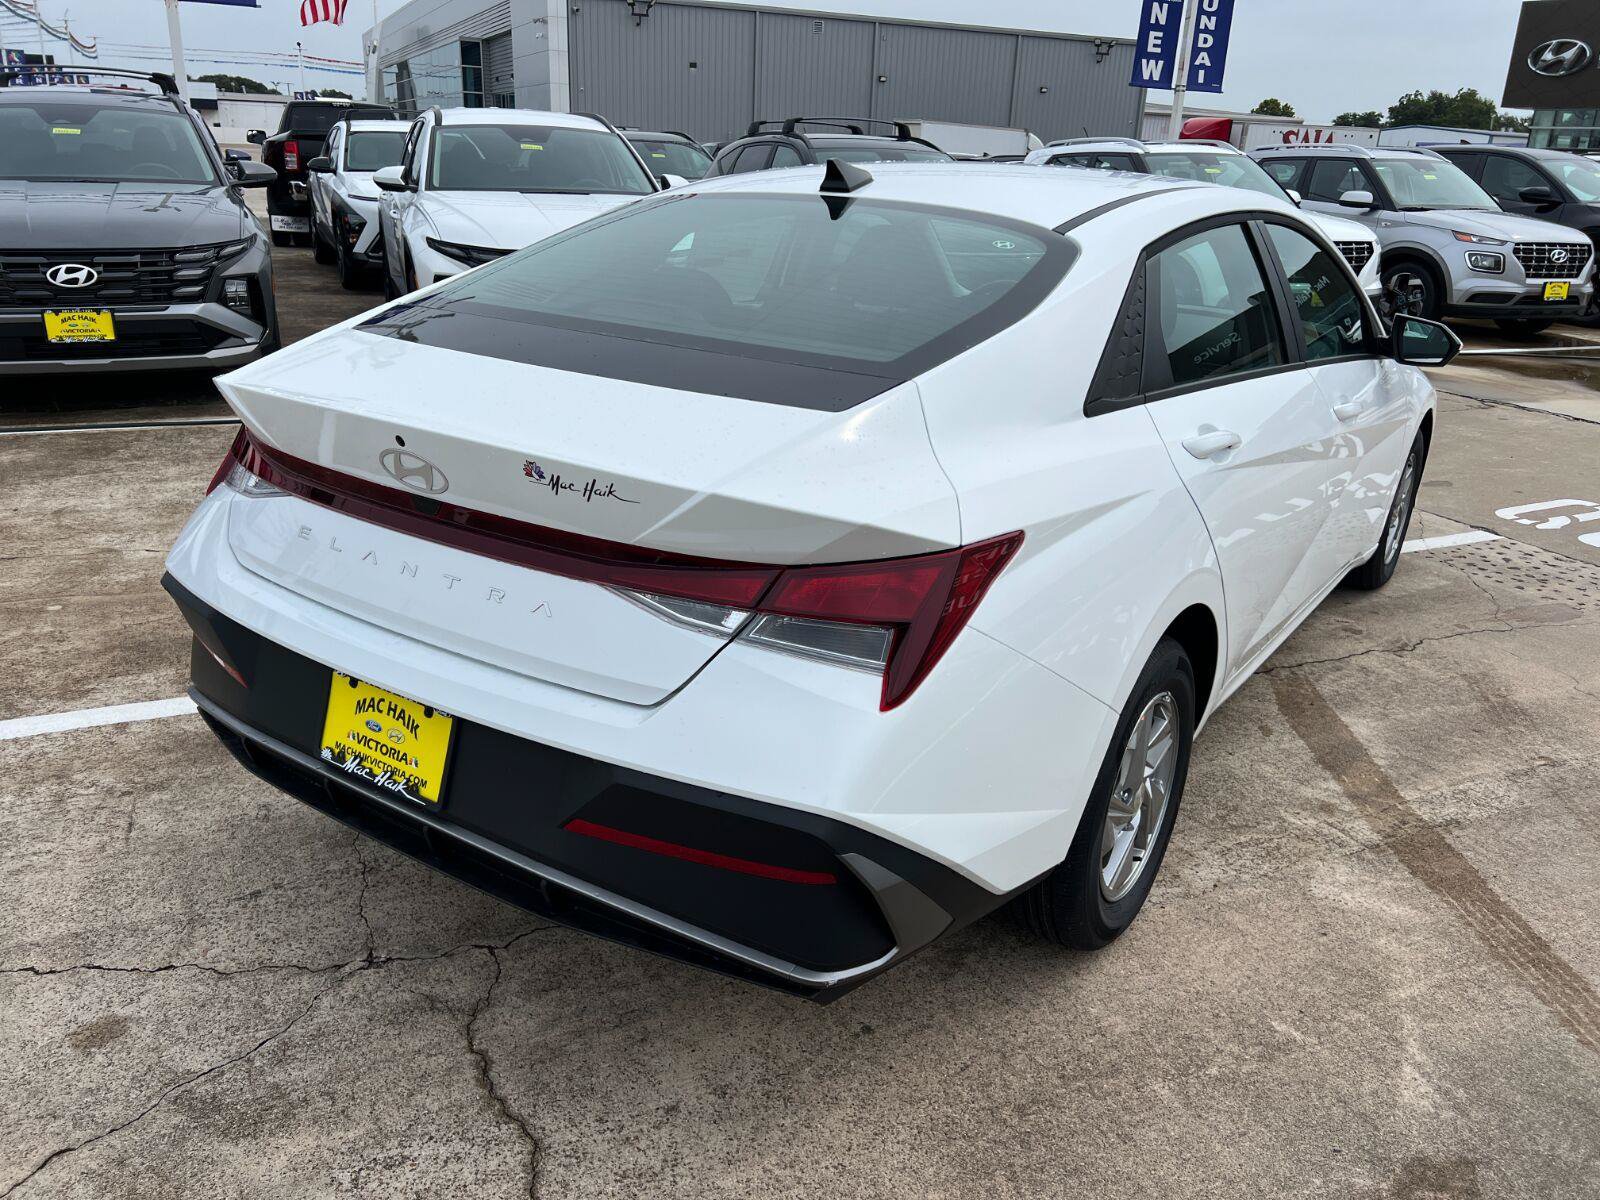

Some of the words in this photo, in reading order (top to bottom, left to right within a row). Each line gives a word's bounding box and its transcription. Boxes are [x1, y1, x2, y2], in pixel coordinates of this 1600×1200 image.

[1141, 2, 1168, 81] NEW
[1194, 0, 1218, 84] UNDAI
[61, 315, 76, 324] MAC
[78, 315, 97, 324] HAIK
[548, 474, 580, 495] Mac
[583, 479, 640, 504] Haik
[298, 526, 552, 617] ELANTRA
[355, 697, 385, 716] MAC
[386, 701, 420, 741] HAIK
[334, 741, 428, 789] MACHAIKVICTORIA.COM
[356, 732, 409, 766] VICTORIA
[341, 756, 374, 781] Mac
[374, 771, 426, 805] Haik
